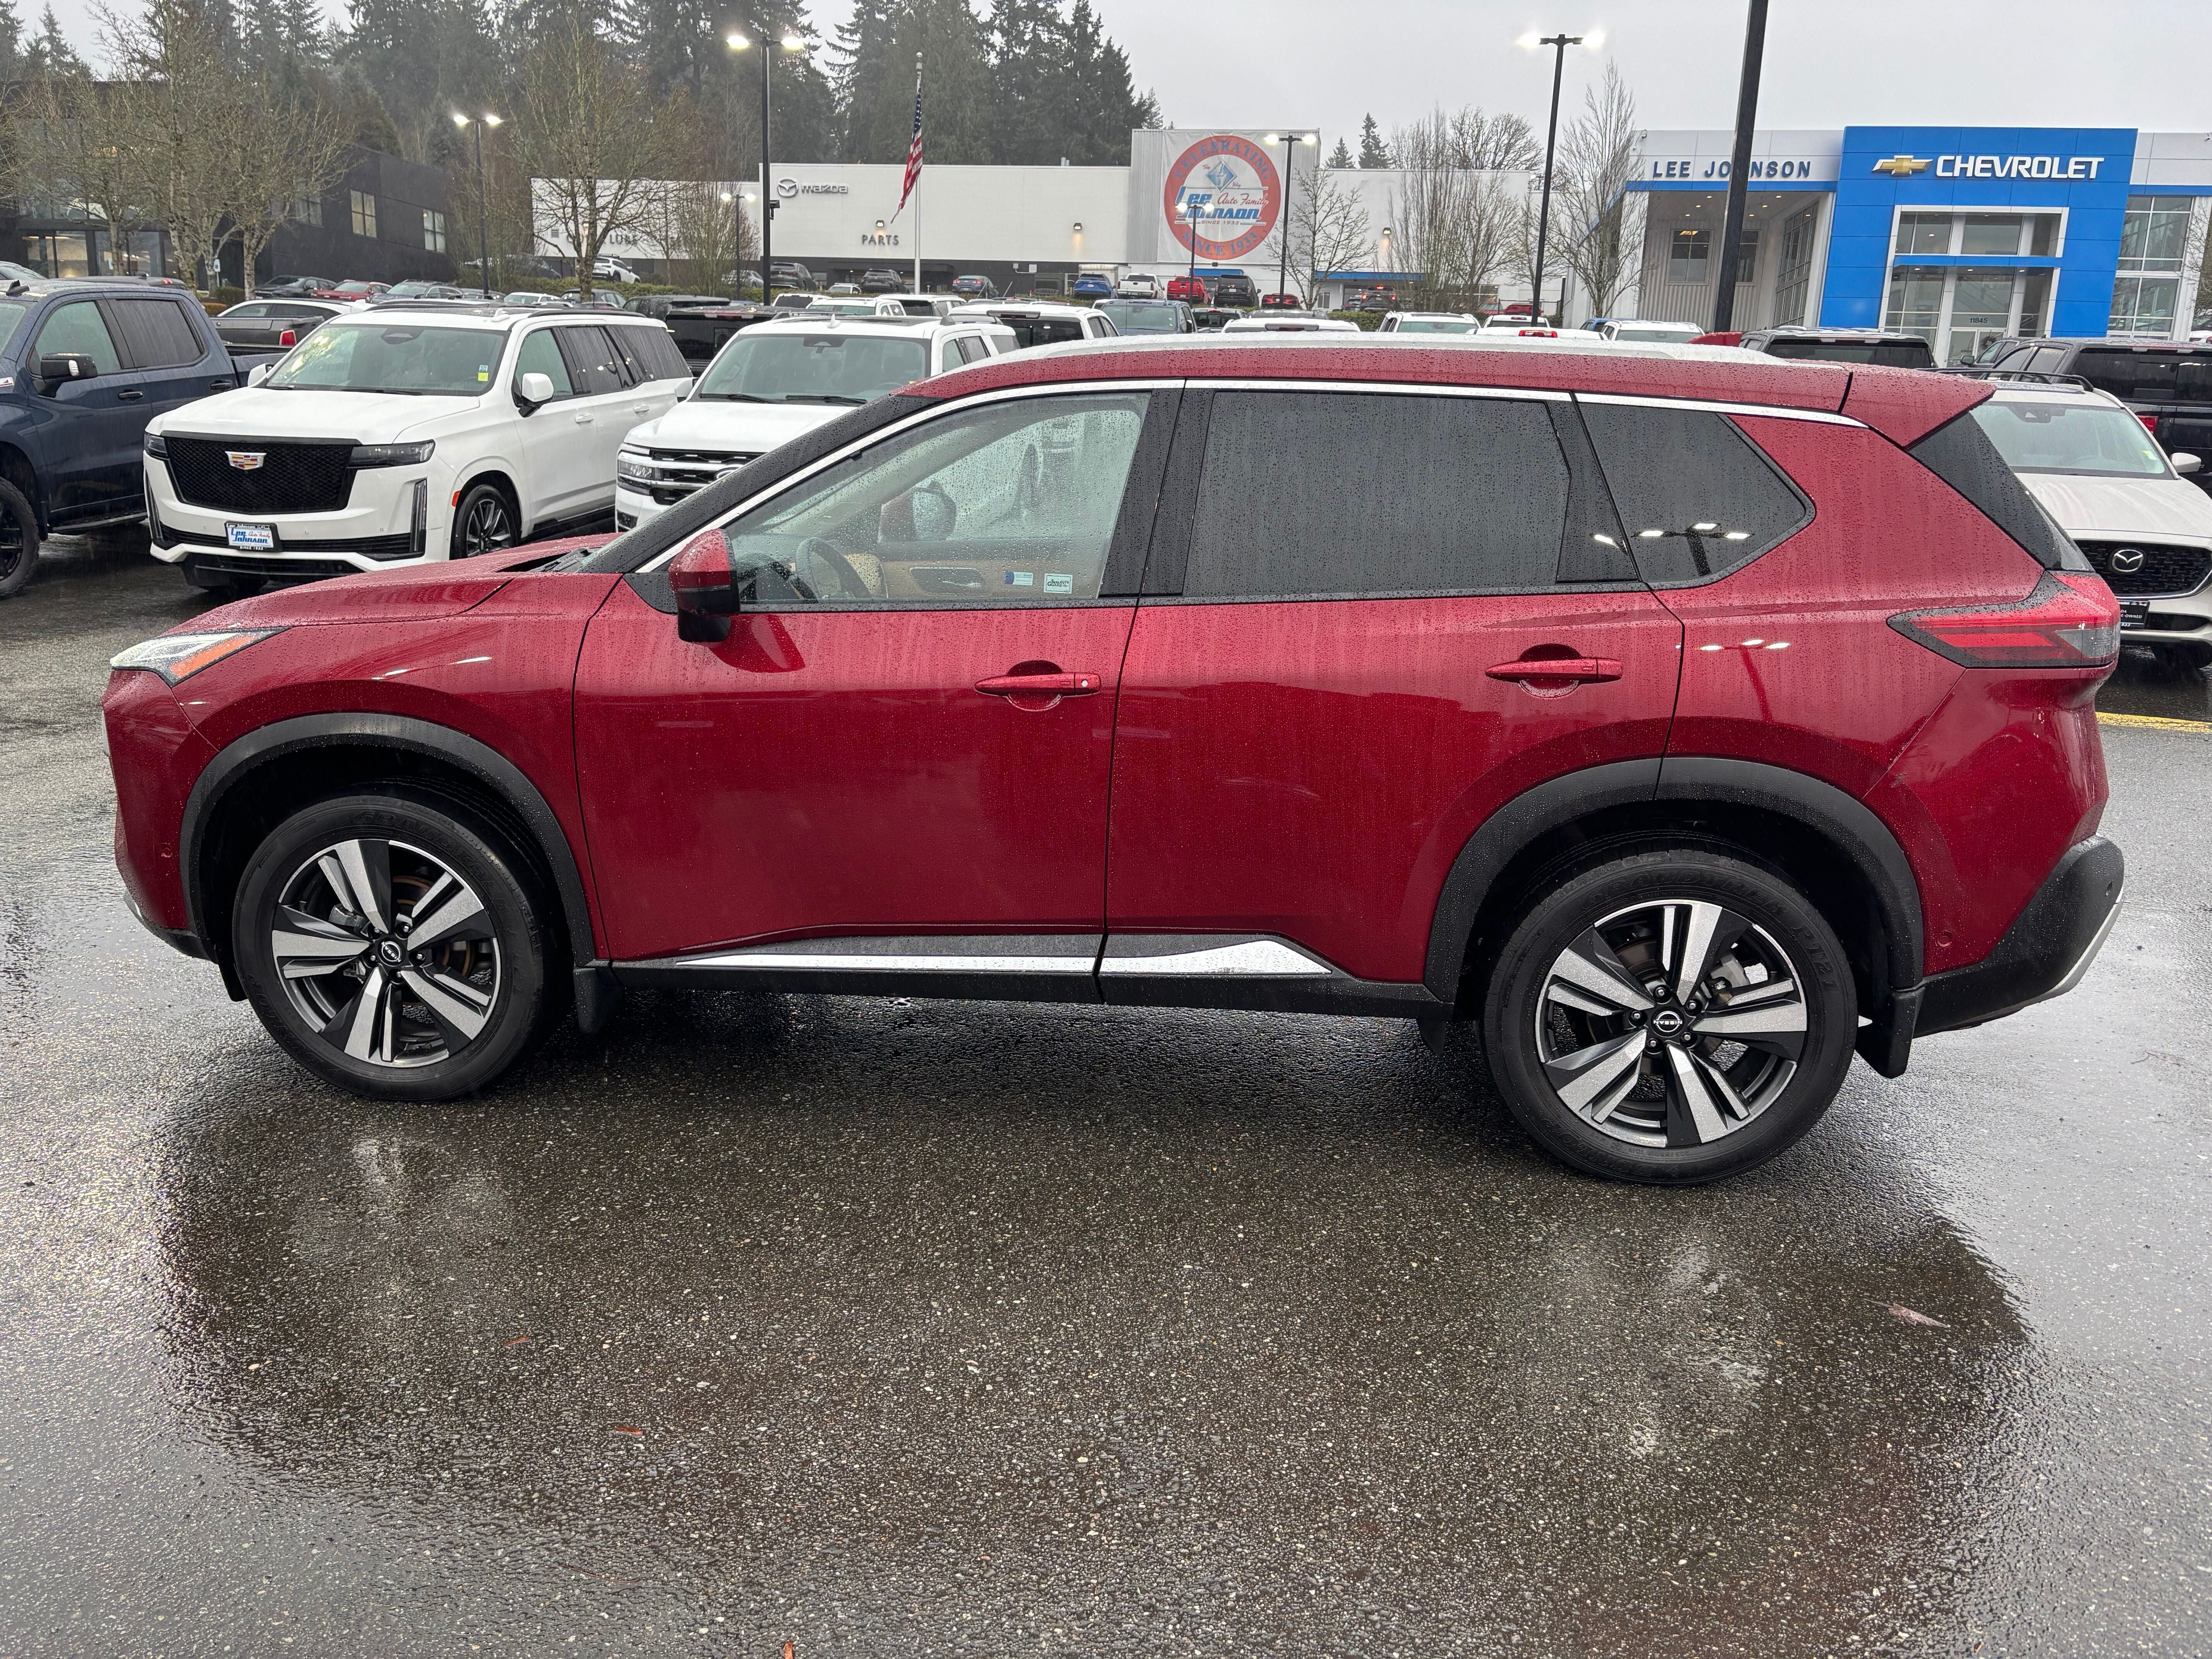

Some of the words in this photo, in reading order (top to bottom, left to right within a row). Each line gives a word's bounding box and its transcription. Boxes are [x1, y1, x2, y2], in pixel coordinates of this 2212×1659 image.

[1175, 139, 1272, 179] CELEBRATING
[1653, 161, 1690, 178] LEE
[1704, 160, 1812, 178] JONSON
[1936, 153, 2104, 179] CHEVROLET
[802, 184, 848, 194] mazda
[1176, 185, 1212, 205] Lee
[1217, 192, 1238, 205] Auto
[1240, 193, 1269, 212] Family
[861, 234, 899, 245] PARTS
[1230, 231, 1259, 254] 1933
[231, 527, 247, 536] Lee
[232, 535, 269, 544] Johnson
[381, 941, 402, 962] NISSAN
[1793, 924, 1836, 992] PT21
